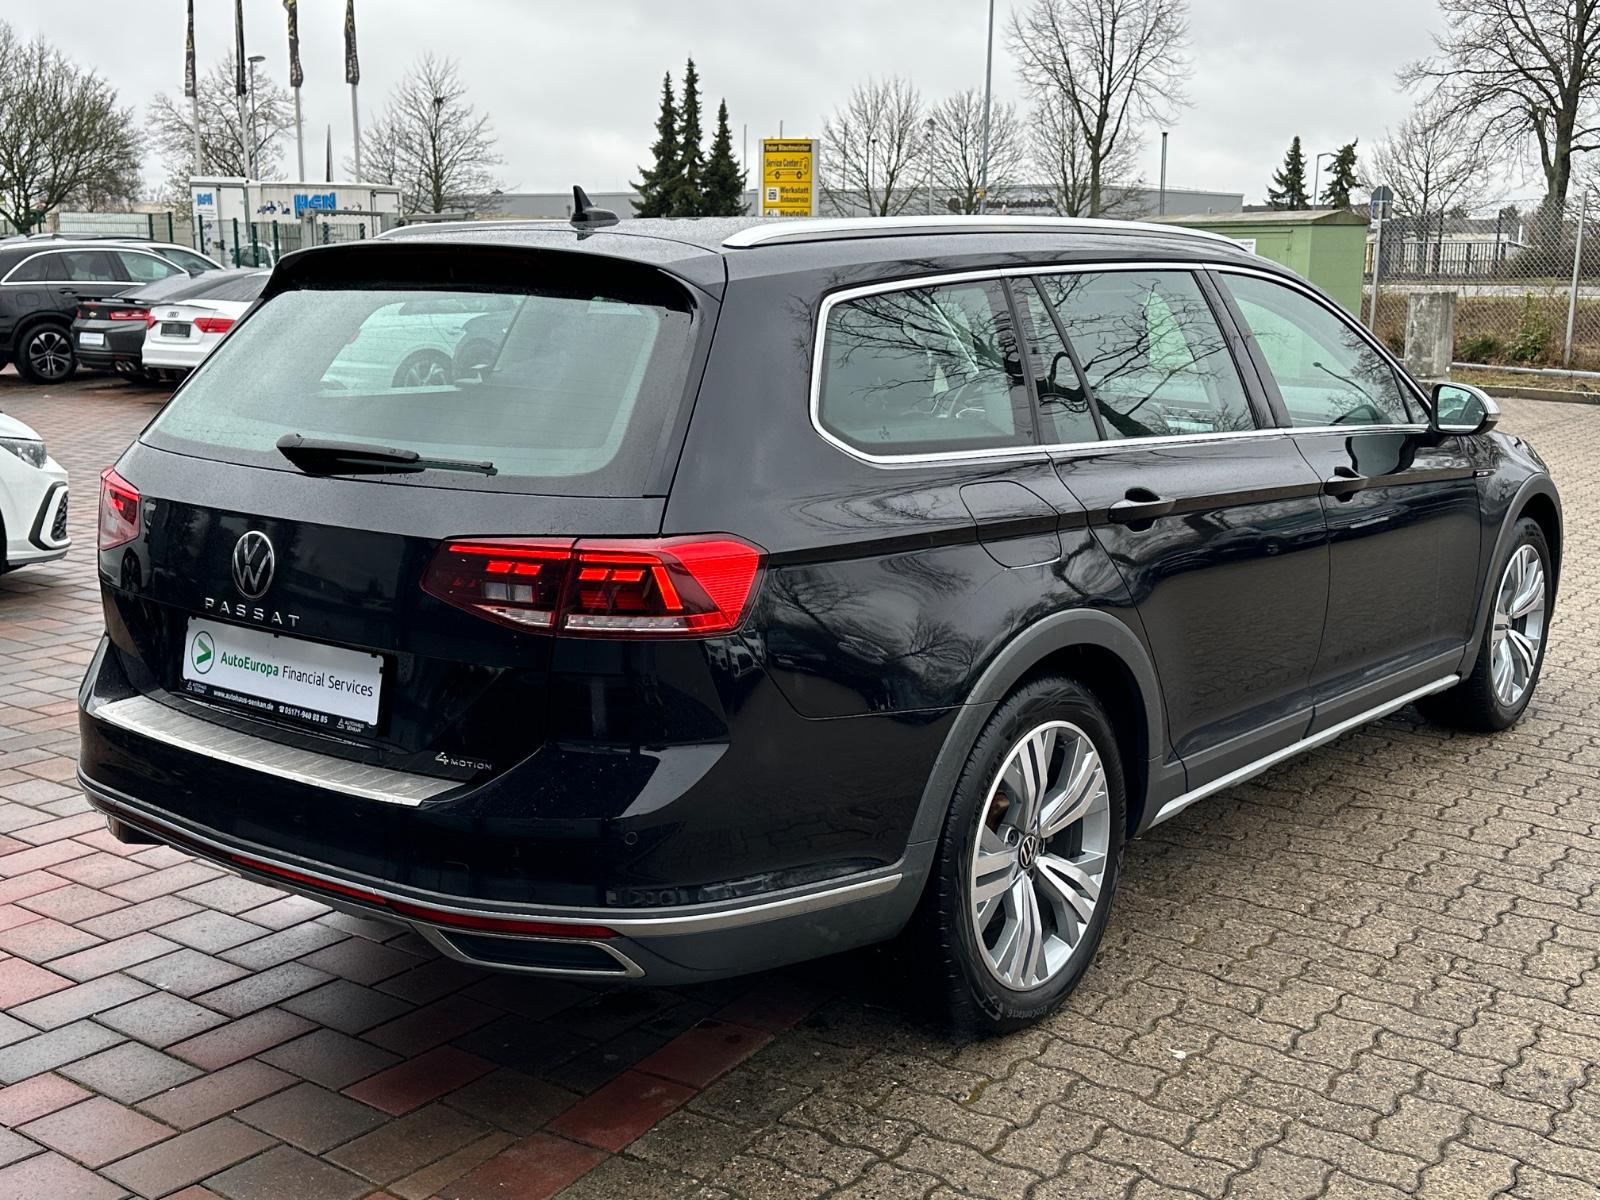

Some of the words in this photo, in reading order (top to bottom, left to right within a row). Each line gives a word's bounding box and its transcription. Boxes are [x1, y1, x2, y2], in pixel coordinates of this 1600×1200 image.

[766, 158, 782, 168] Service
[783, 158, 799, 168] Center
[780, 186, 809, 194] Werkstatt
[204, 597, 300, 627] PASSAT
[220, 651, 280, 678] AutoEuropa
[282, 665, 325, 687] Financial
[328, 675, 374, 697] Services
